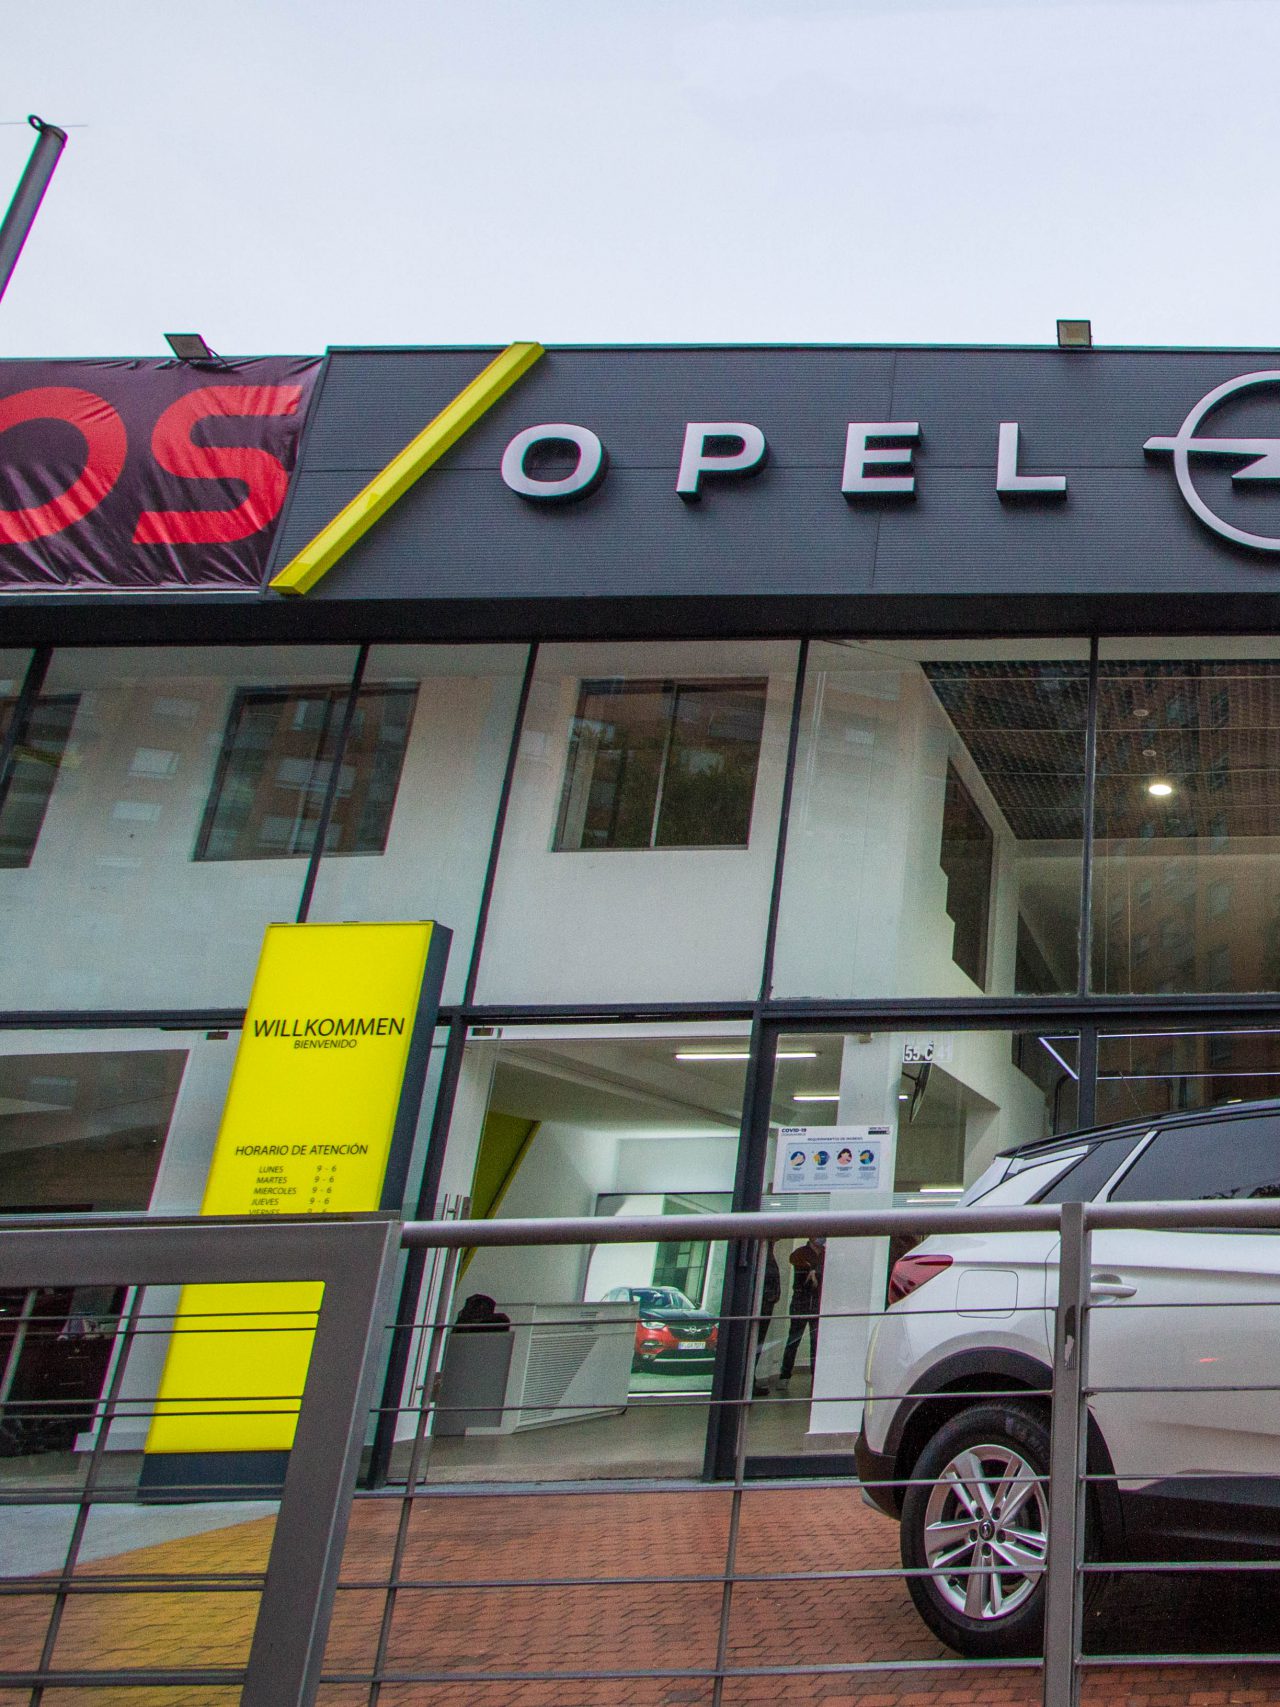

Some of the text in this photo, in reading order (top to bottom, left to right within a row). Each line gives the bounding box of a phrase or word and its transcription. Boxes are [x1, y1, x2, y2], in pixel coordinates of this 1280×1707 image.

[501, 421, 1067, 498] OPEL
[254, 1018, 405, 1037] WILLKOMMEN
[293, 1039, 358, 1049] BIENVENIDO
[235, 1143, 369, 1155] HORARIO DE ATENCIÓN
[258, 1165, 284, 1173] LUNES
[256, 1176, 287, 1184] MARTES
